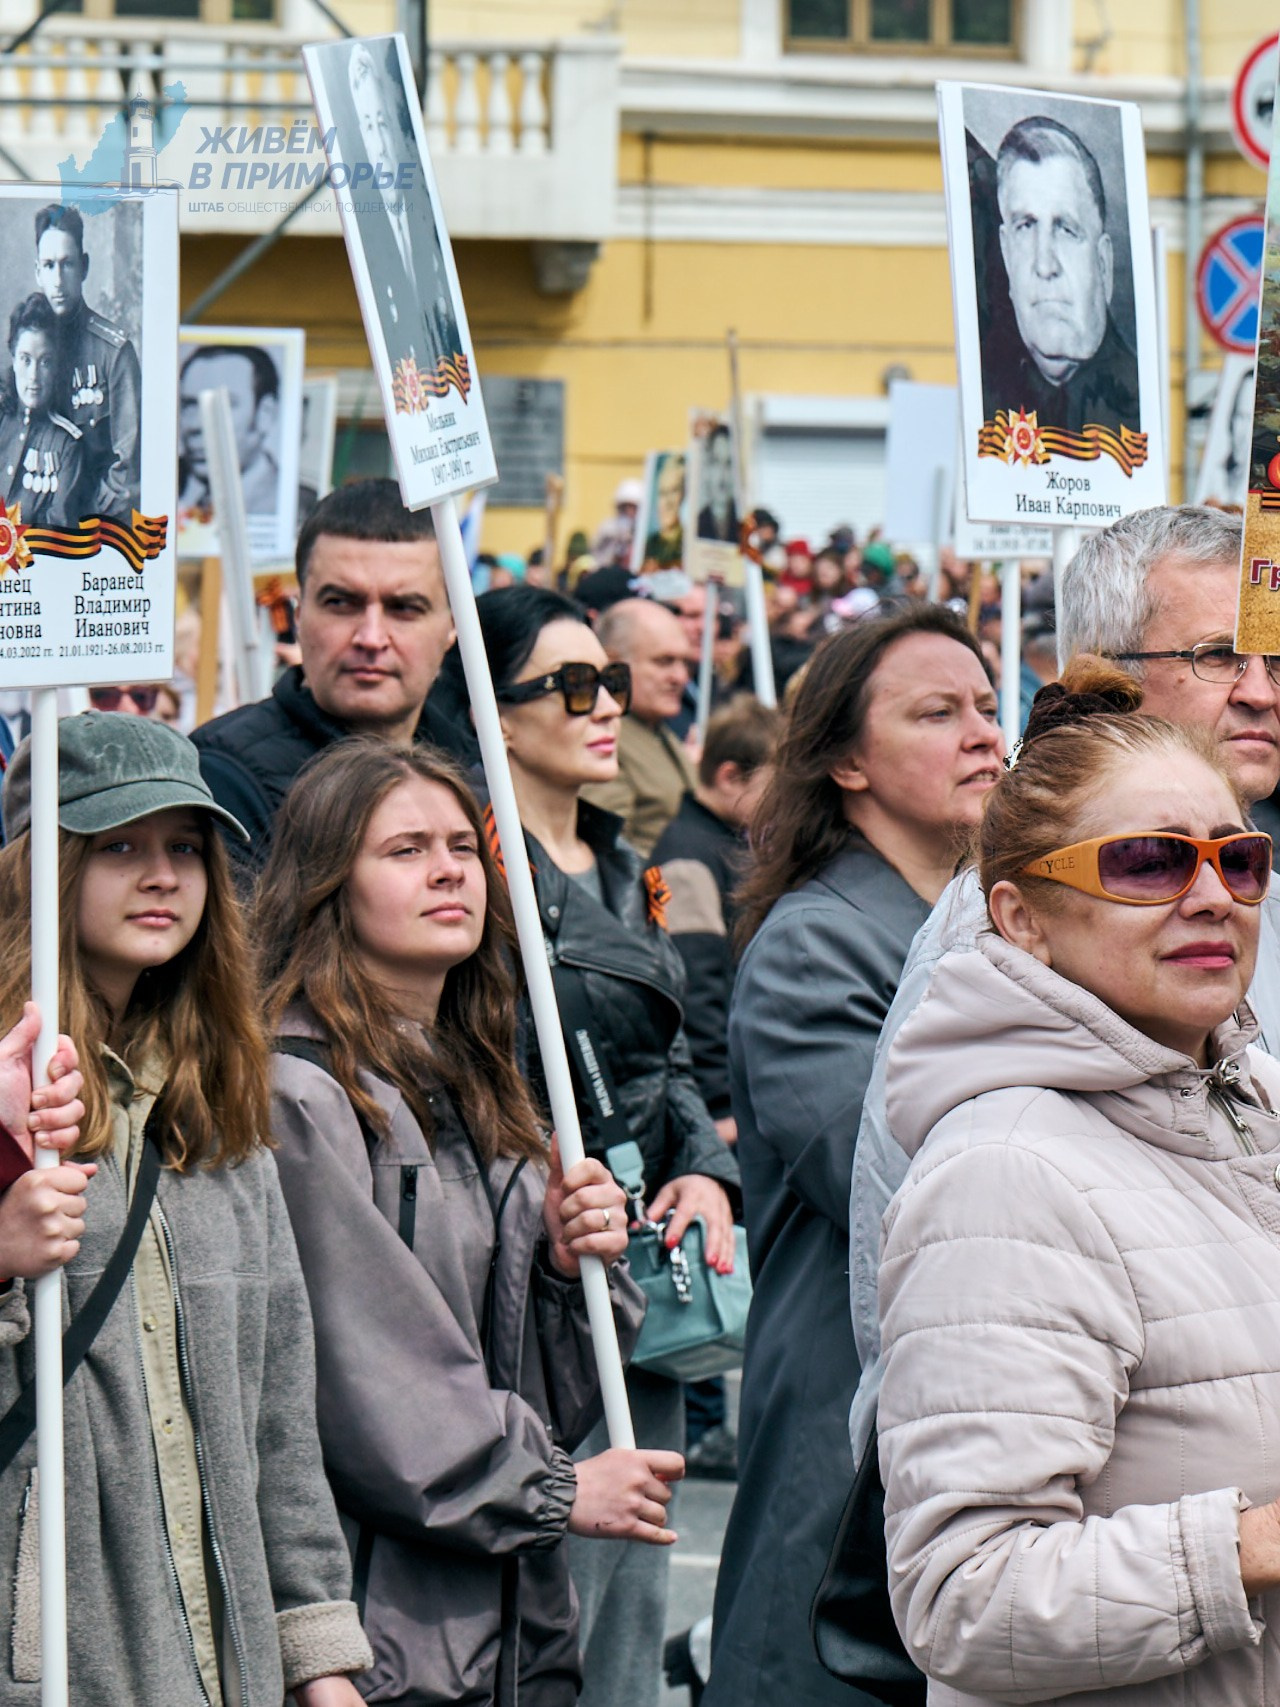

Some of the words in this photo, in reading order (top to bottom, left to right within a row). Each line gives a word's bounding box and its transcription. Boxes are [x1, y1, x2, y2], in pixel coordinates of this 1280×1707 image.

[1046, 471, 1091, 495] Жоров
[1015, 494, 1051, 513] Иван
[1056, 496, 1122, 520] Карпович
[82, 572, 145, 595] Баранец
[74, 595, 151, 617] Владимир
[75, 618, 149, 638] Иванович
